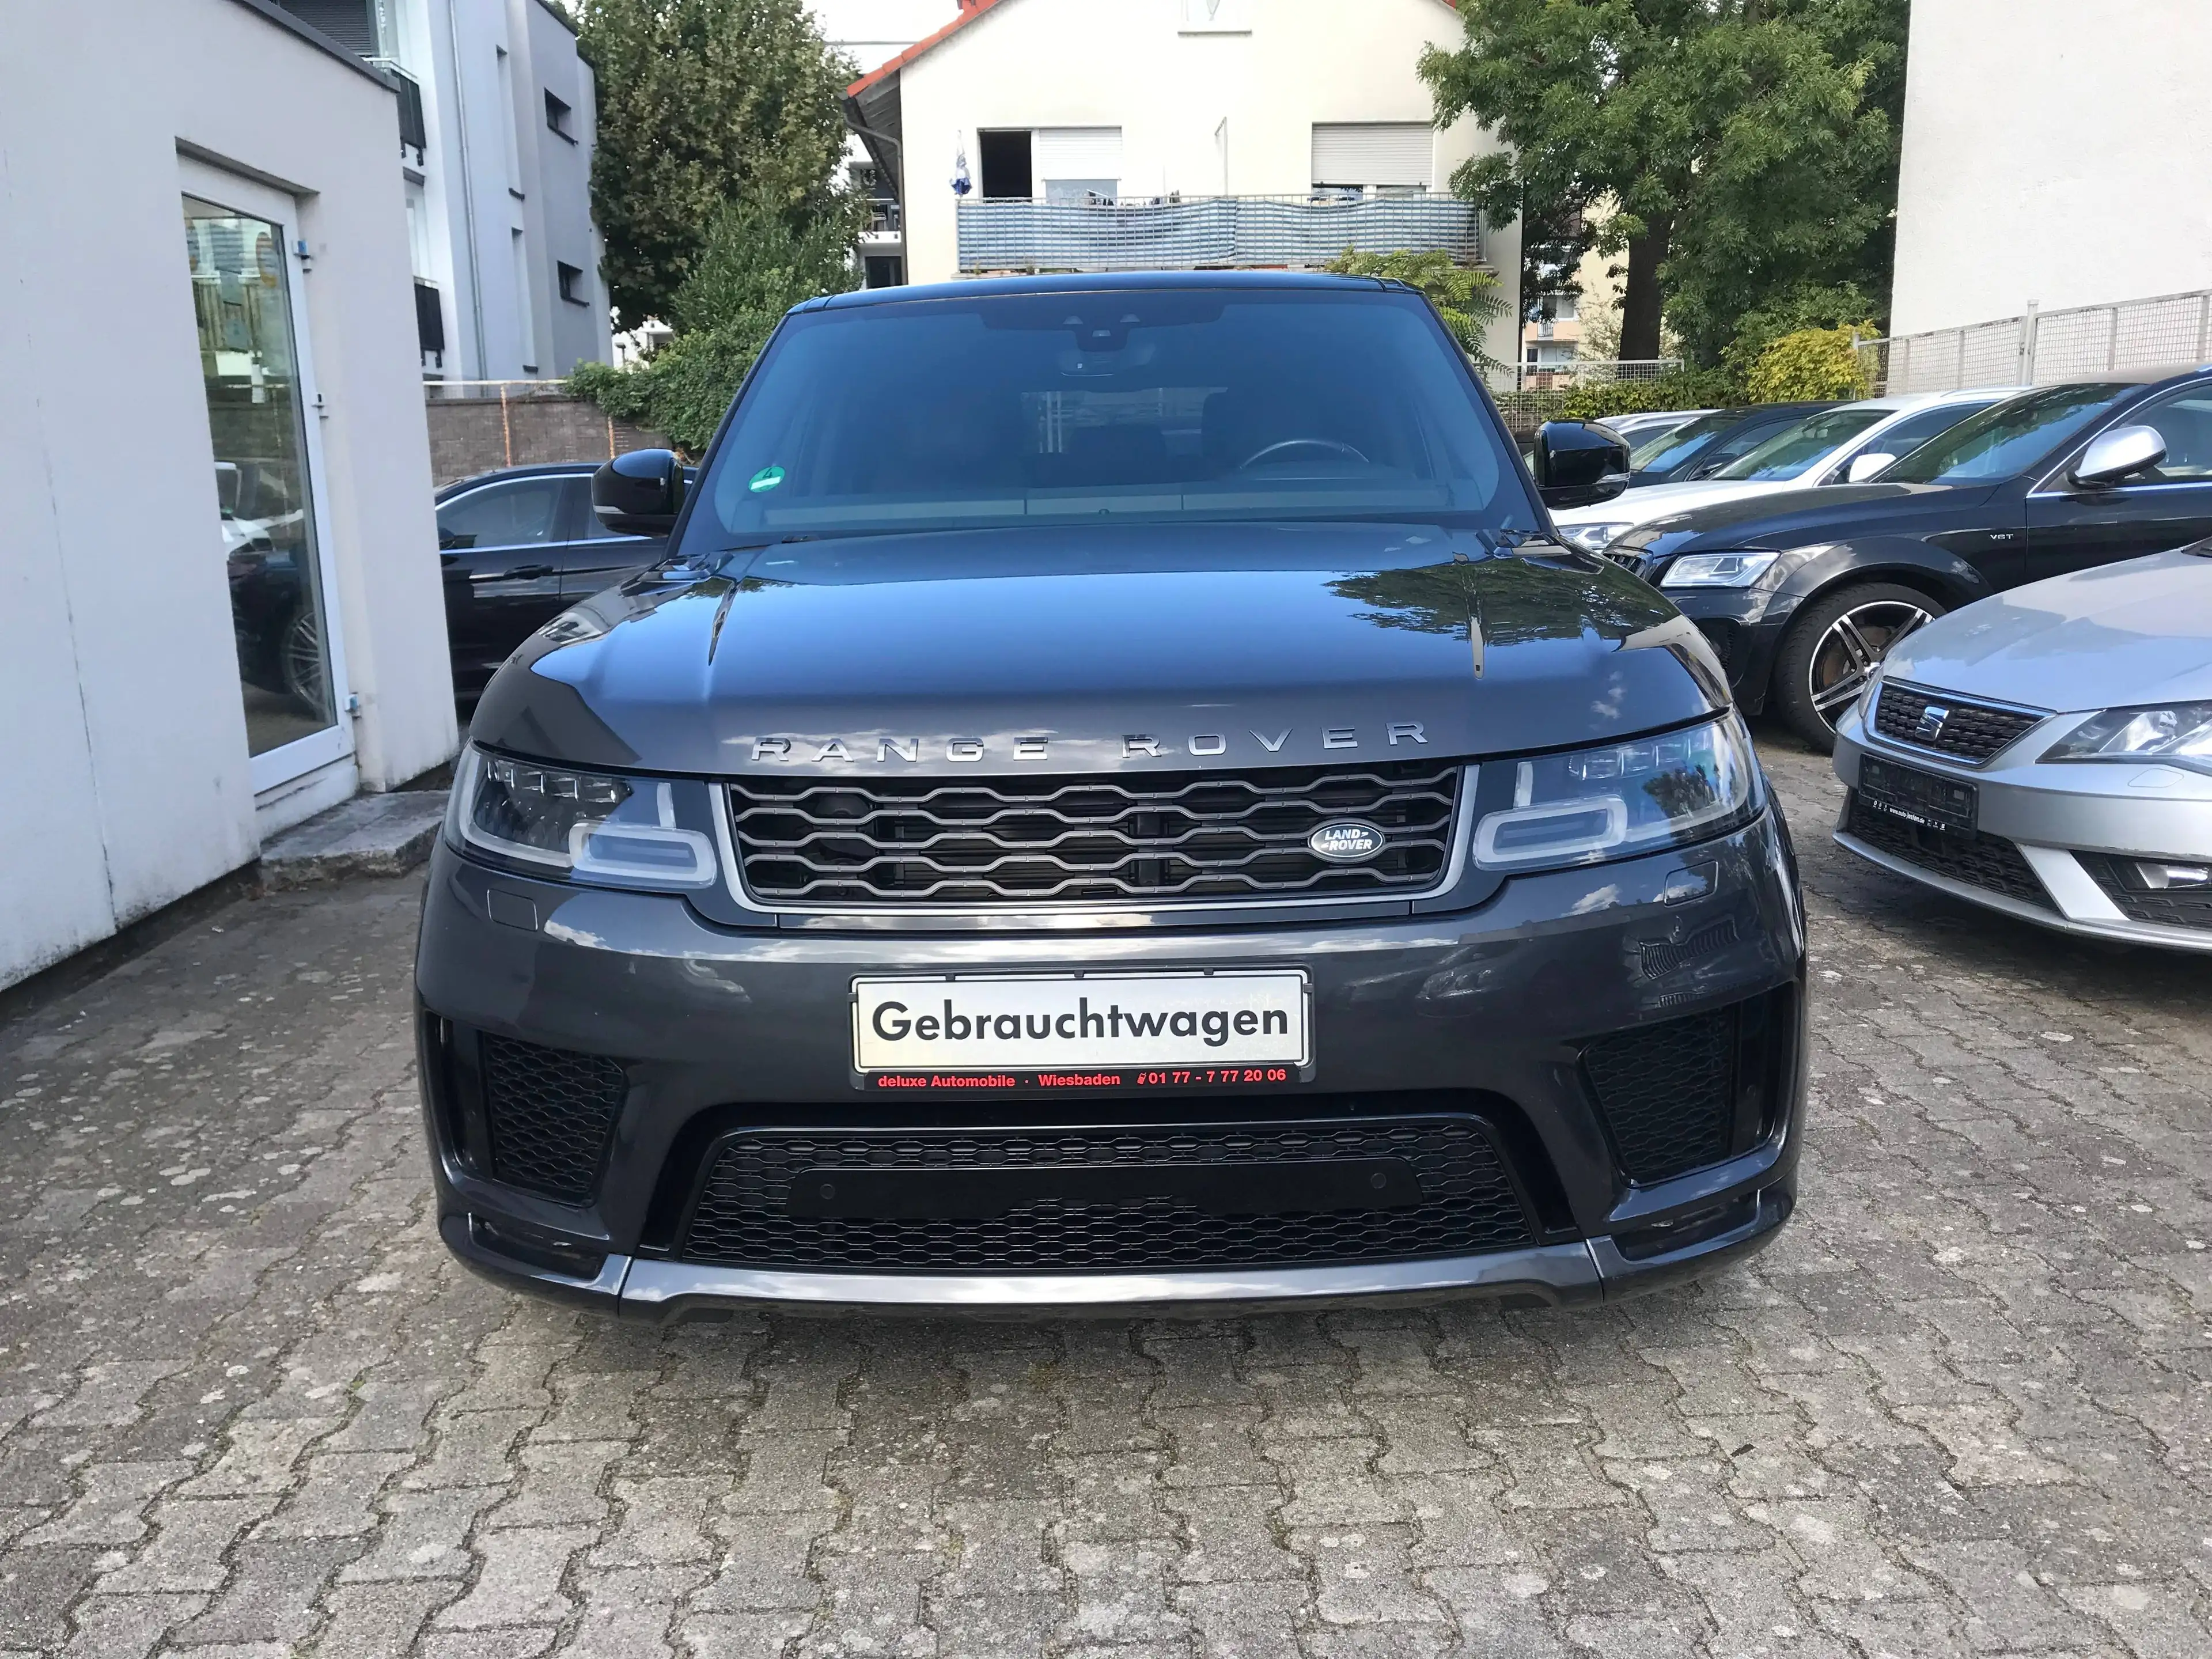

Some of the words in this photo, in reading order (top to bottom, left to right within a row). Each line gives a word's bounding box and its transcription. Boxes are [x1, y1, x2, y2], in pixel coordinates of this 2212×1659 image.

[762, 467, 773, 479] 4
[751, 736, 1048, 762] RANGE
[1122, 720, 1428, 759] ROVER
[1325, 828, 1361, 840] LAND
[1328, 839, 1373, 851] ROVER
[872, 997, 1288, 1047] Gebrauchtwagen
[877, 1075, 927, 1088] deluxe
[930, 1074, 1016, 1088] Automobile
[1037, 1073, 1122, 1087] Wiesbaden
[1148, 1071, 1166, 1085] 01
[1172, 1071, 1191, 1084] 77
[1206, 1070, 1215, 1082] 7
[1220, 1070, 1240, 1082] 77
[1243, 1069, 1264, 1082] 20
[1266, 1069, 1287, 1081] 06
